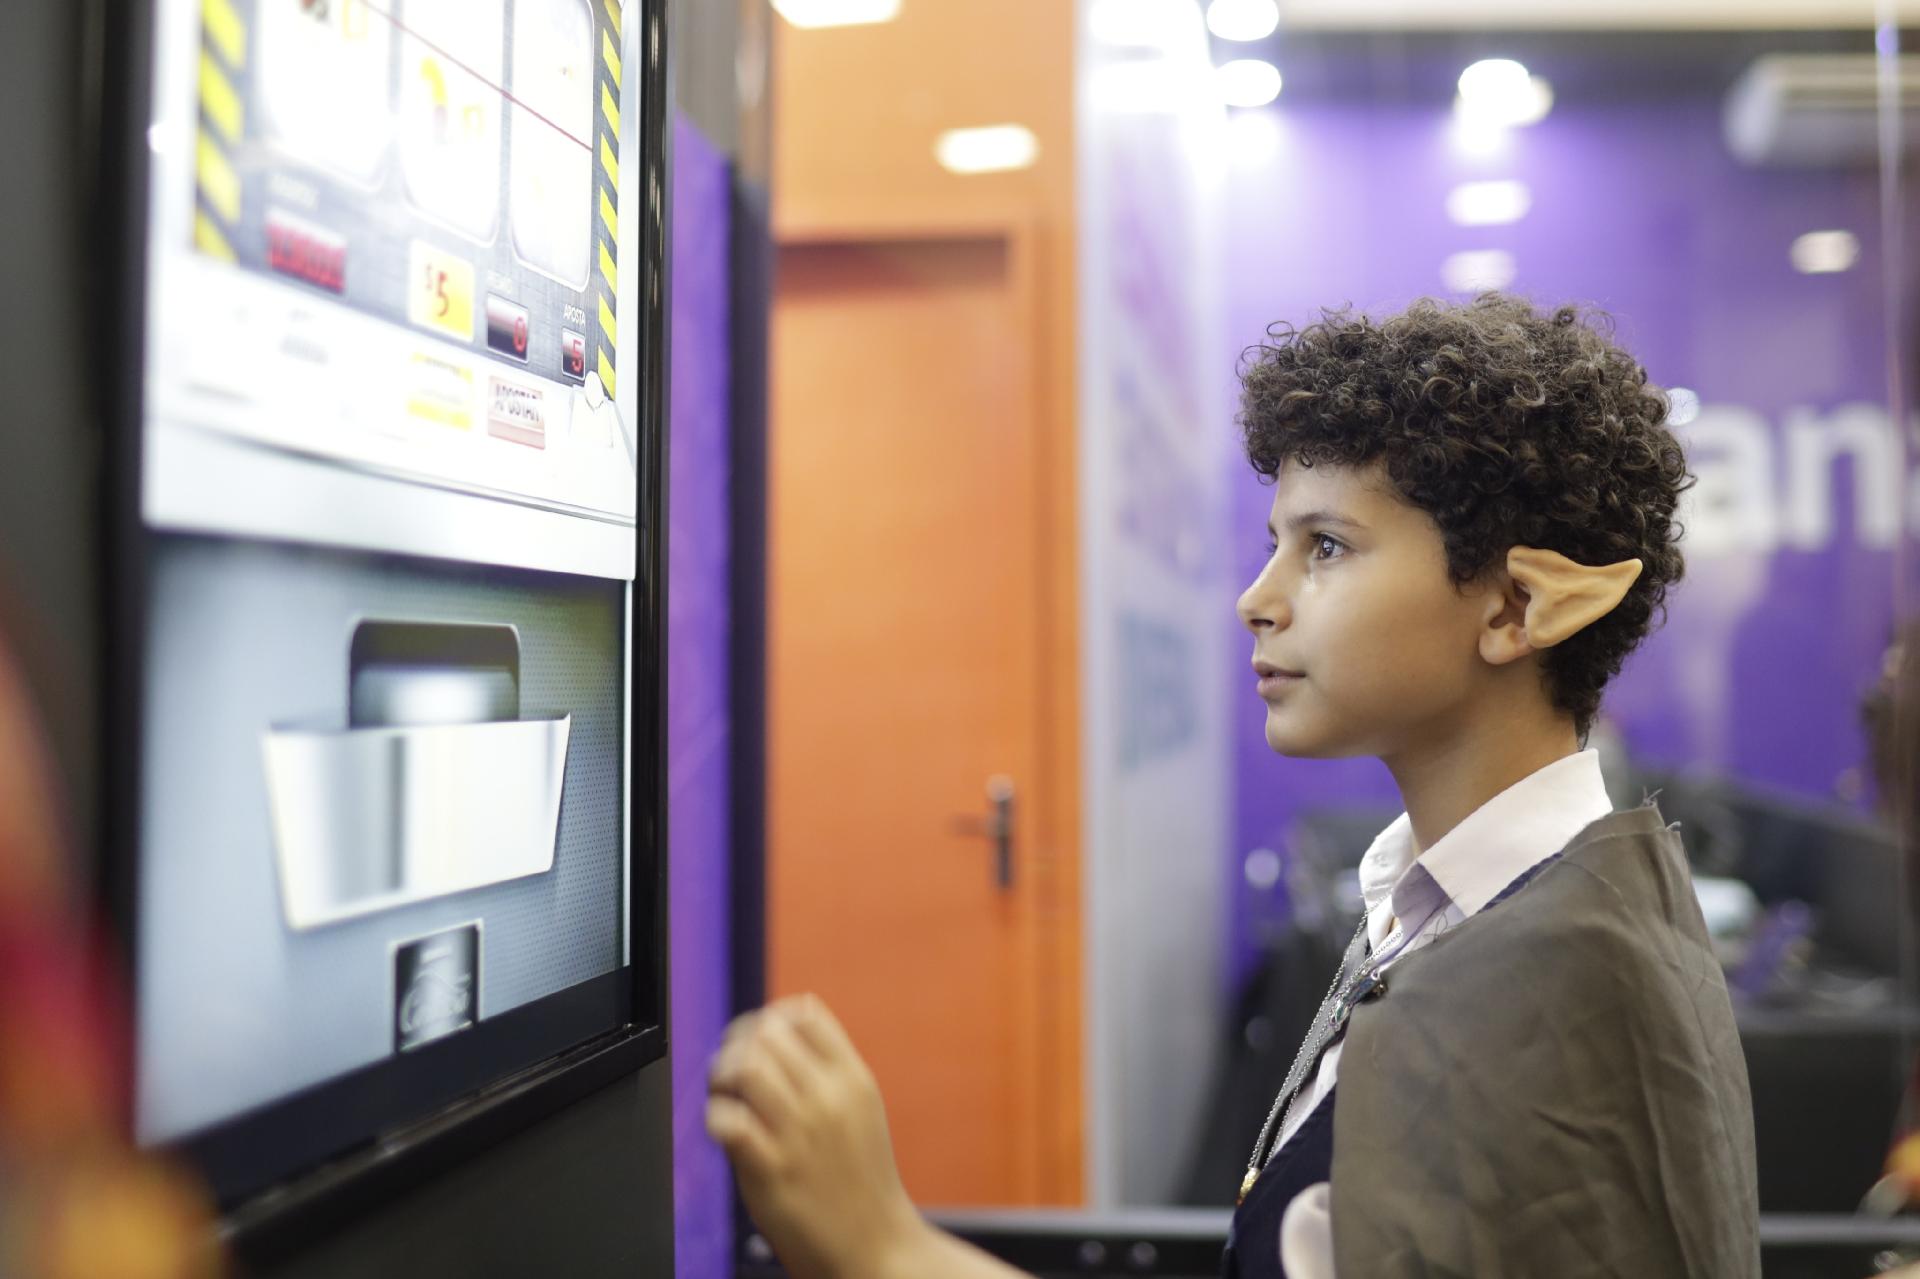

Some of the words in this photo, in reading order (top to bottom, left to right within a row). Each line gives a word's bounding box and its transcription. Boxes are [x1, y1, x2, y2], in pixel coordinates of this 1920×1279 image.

[562, 303, 586, 326] APOSTA
[512, 315, 528, 354] 0
[571, 338, 583, 374] 5
[1677, 401, 1920, 554] an
